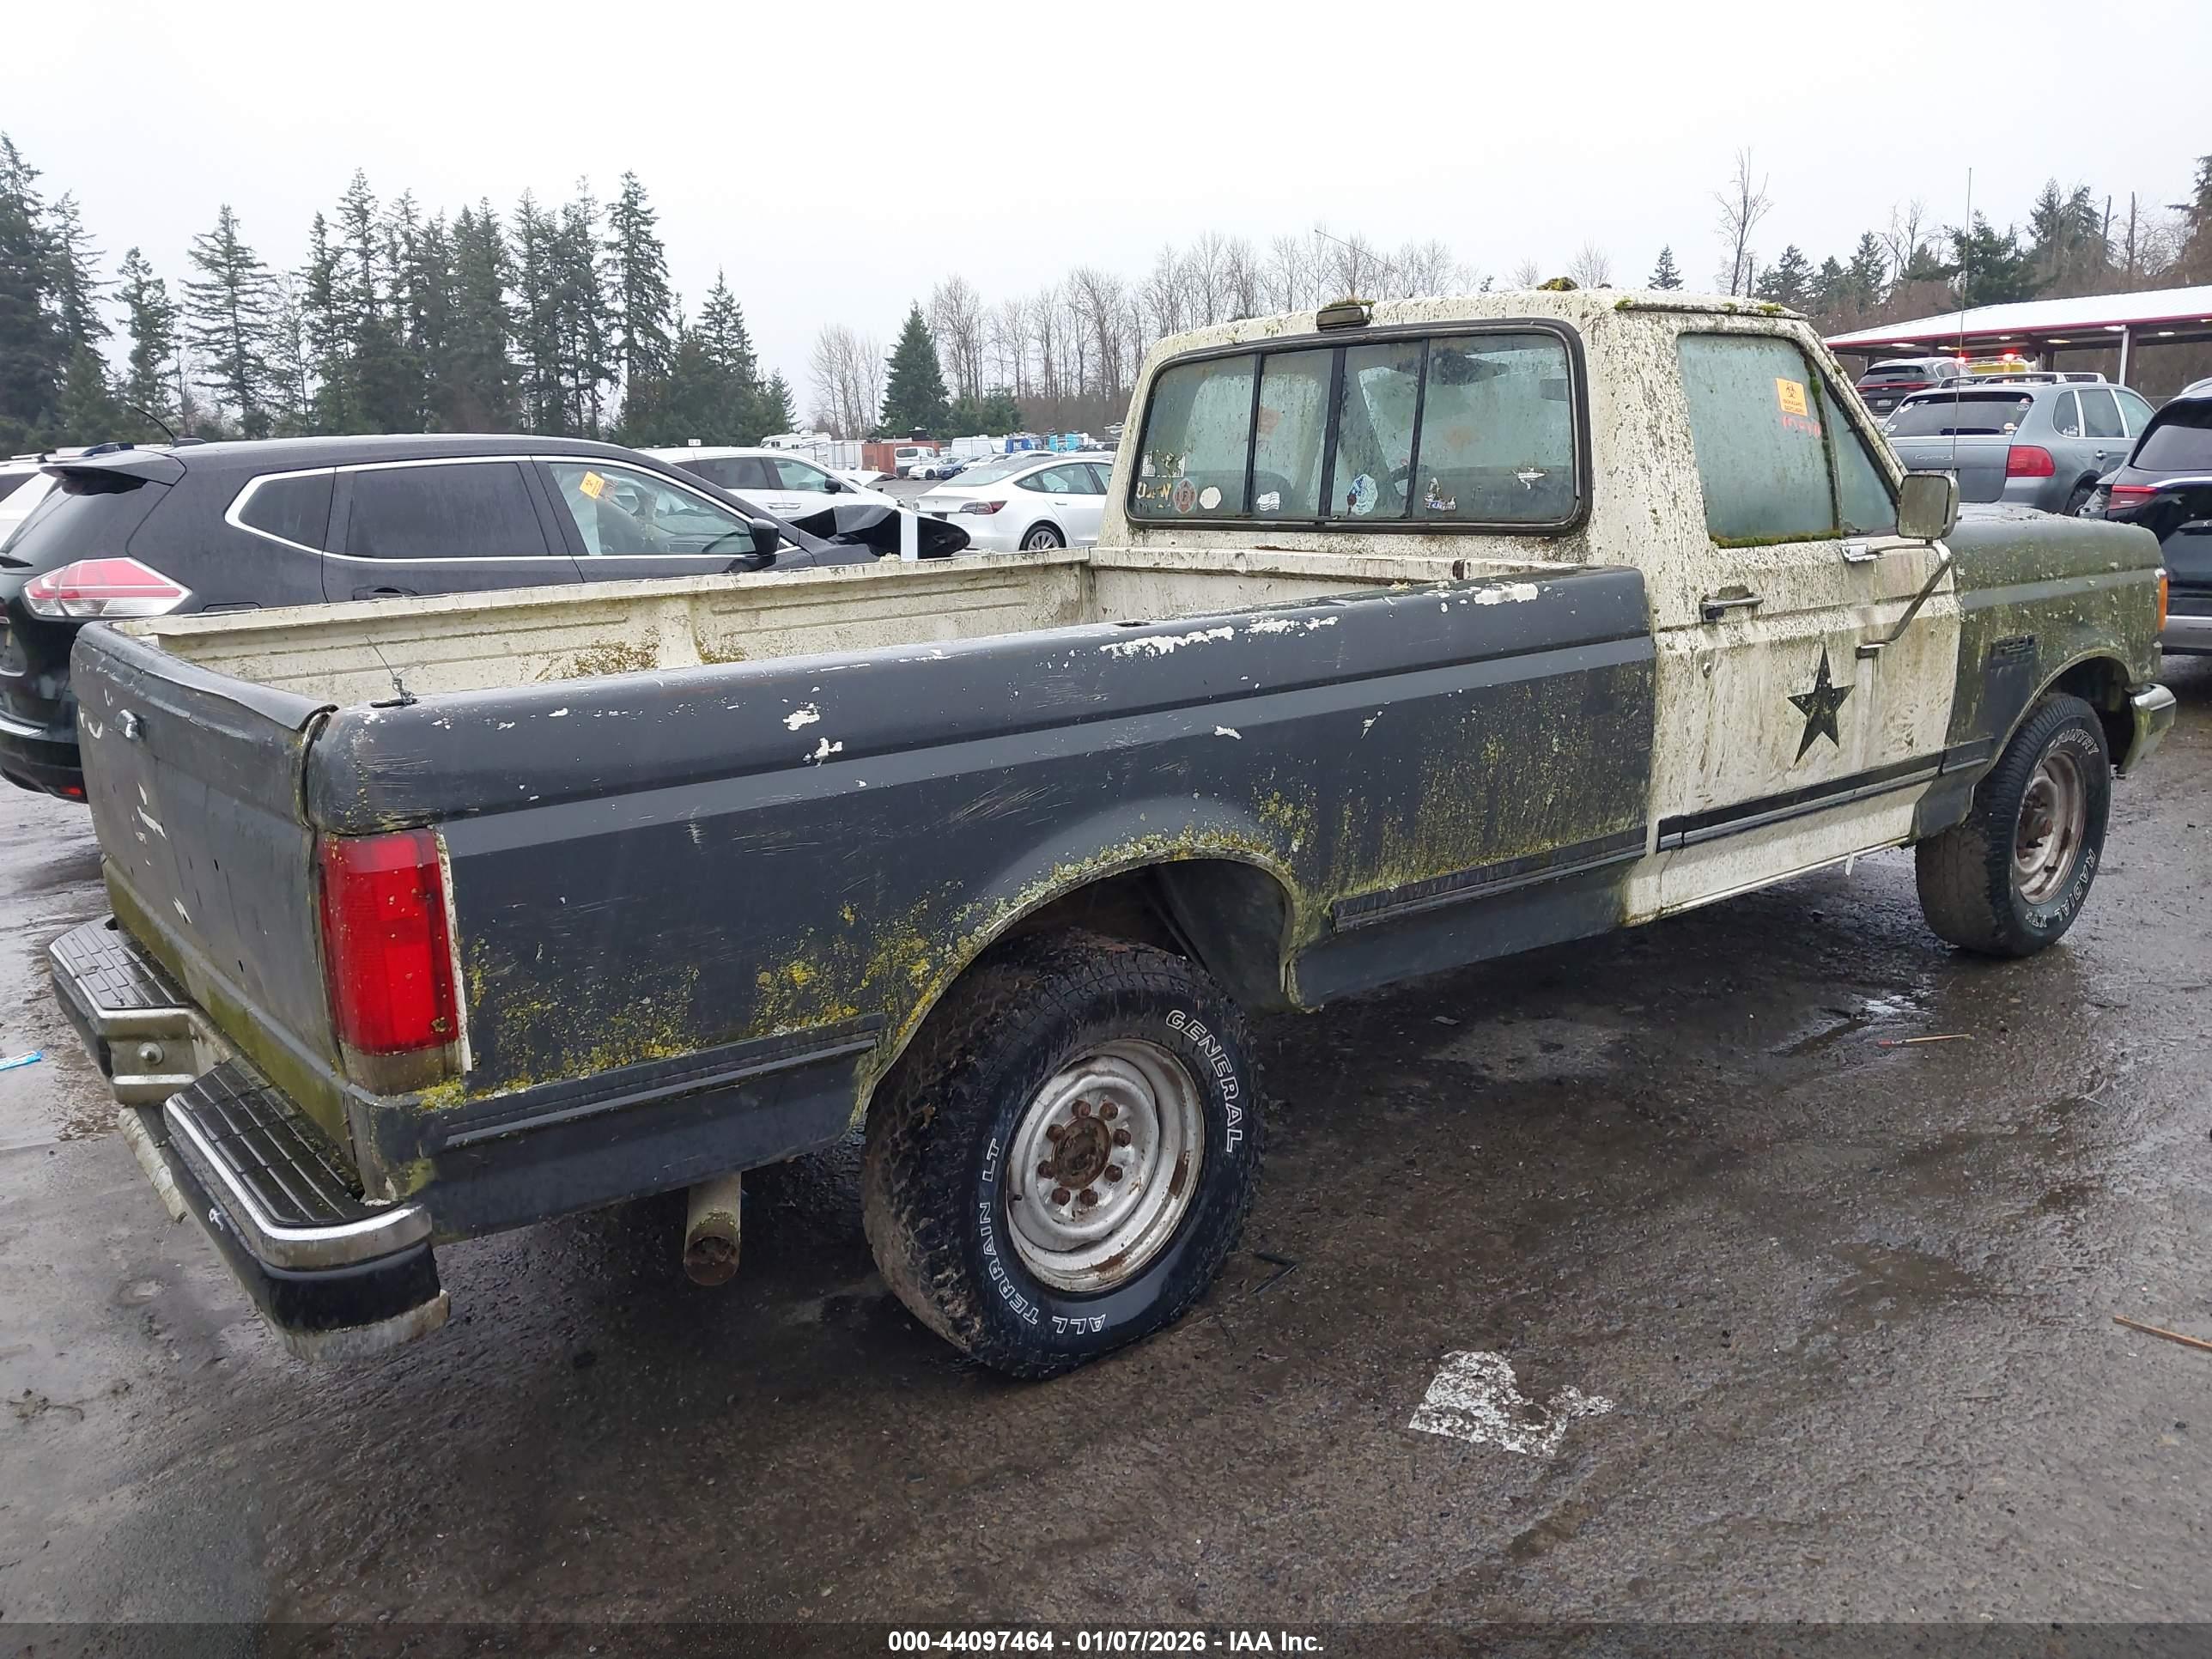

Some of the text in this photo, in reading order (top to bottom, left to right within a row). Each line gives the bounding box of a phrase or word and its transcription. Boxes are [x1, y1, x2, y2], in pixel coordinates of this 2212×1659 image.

[2054, 848, 2096, 921] RADIAL
[1165, 1009, 1243, 1152] GENERAL
[980, 1138, 1107, 1334] ALL TERRAIN LT
